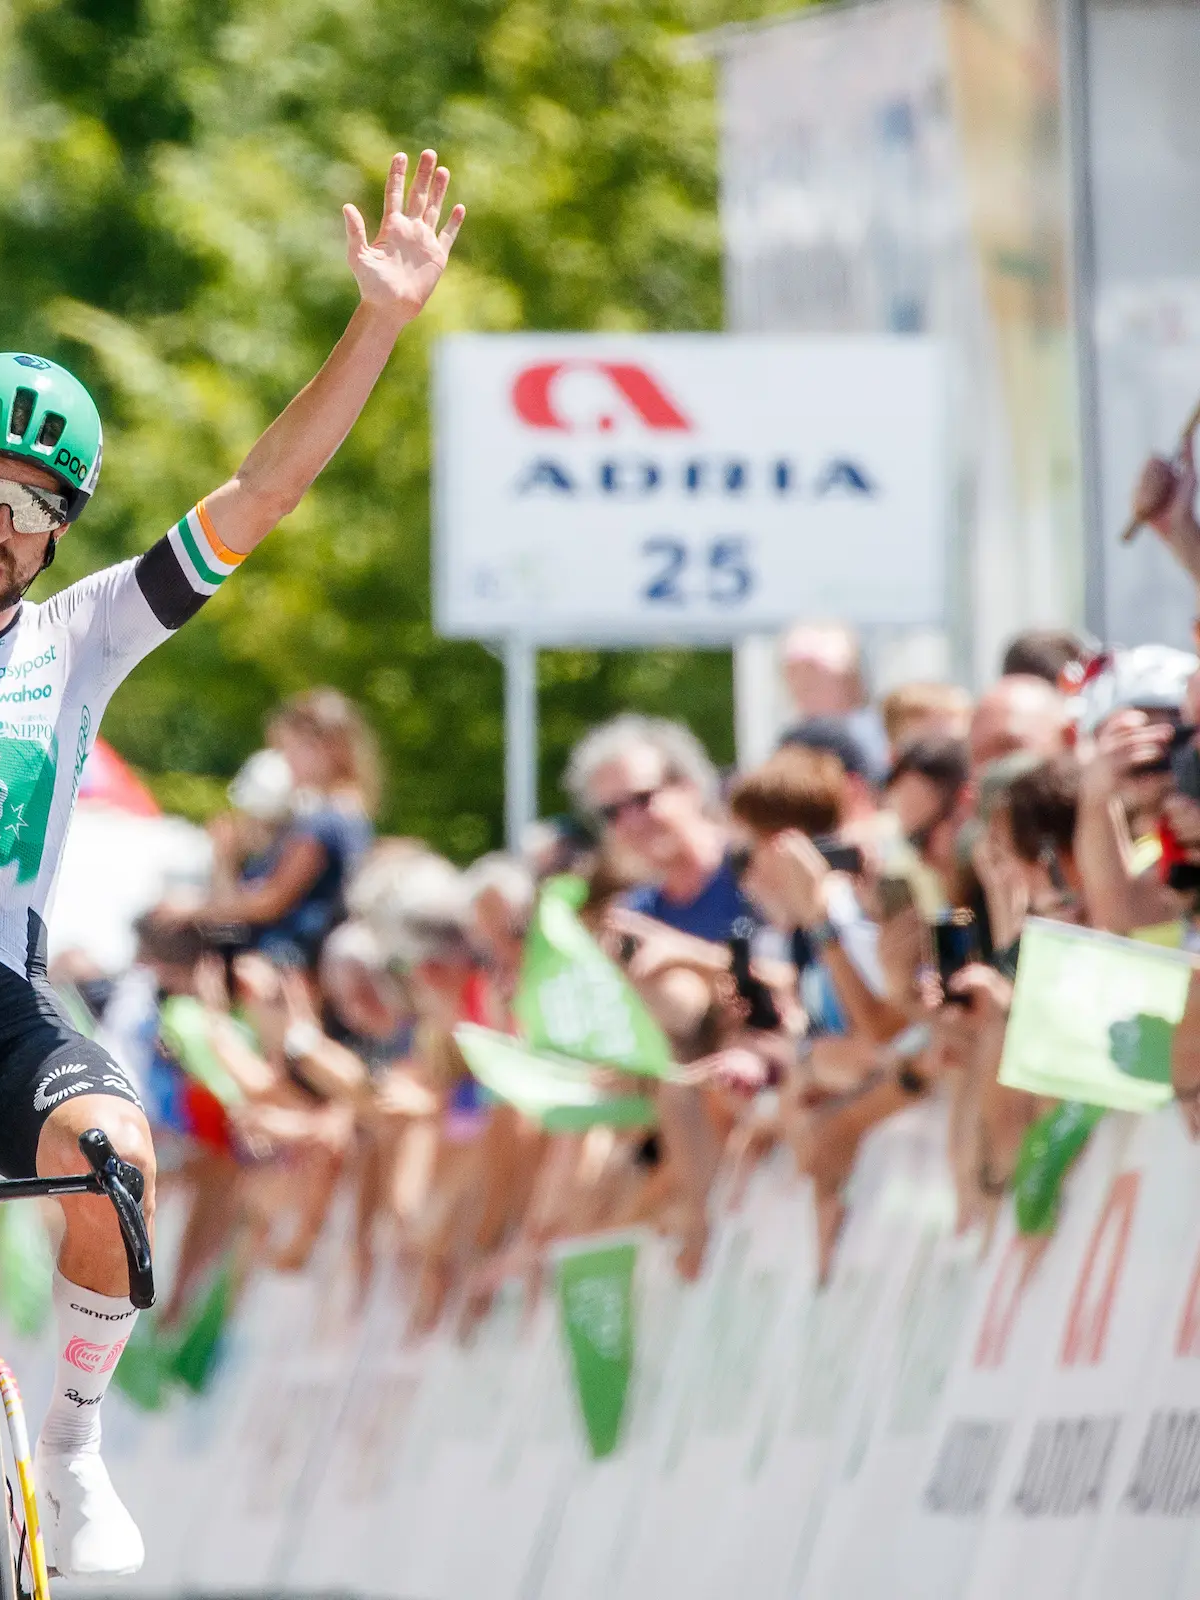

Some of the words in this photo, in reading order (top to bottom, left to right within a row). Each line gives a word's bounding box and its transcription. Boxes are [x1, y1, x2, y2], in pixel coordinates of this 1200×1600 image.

[515, 459, 878, 496] ADRIA
[641, 534, 755, 602] 25
[10, 723, 53, 741] NIPPO
